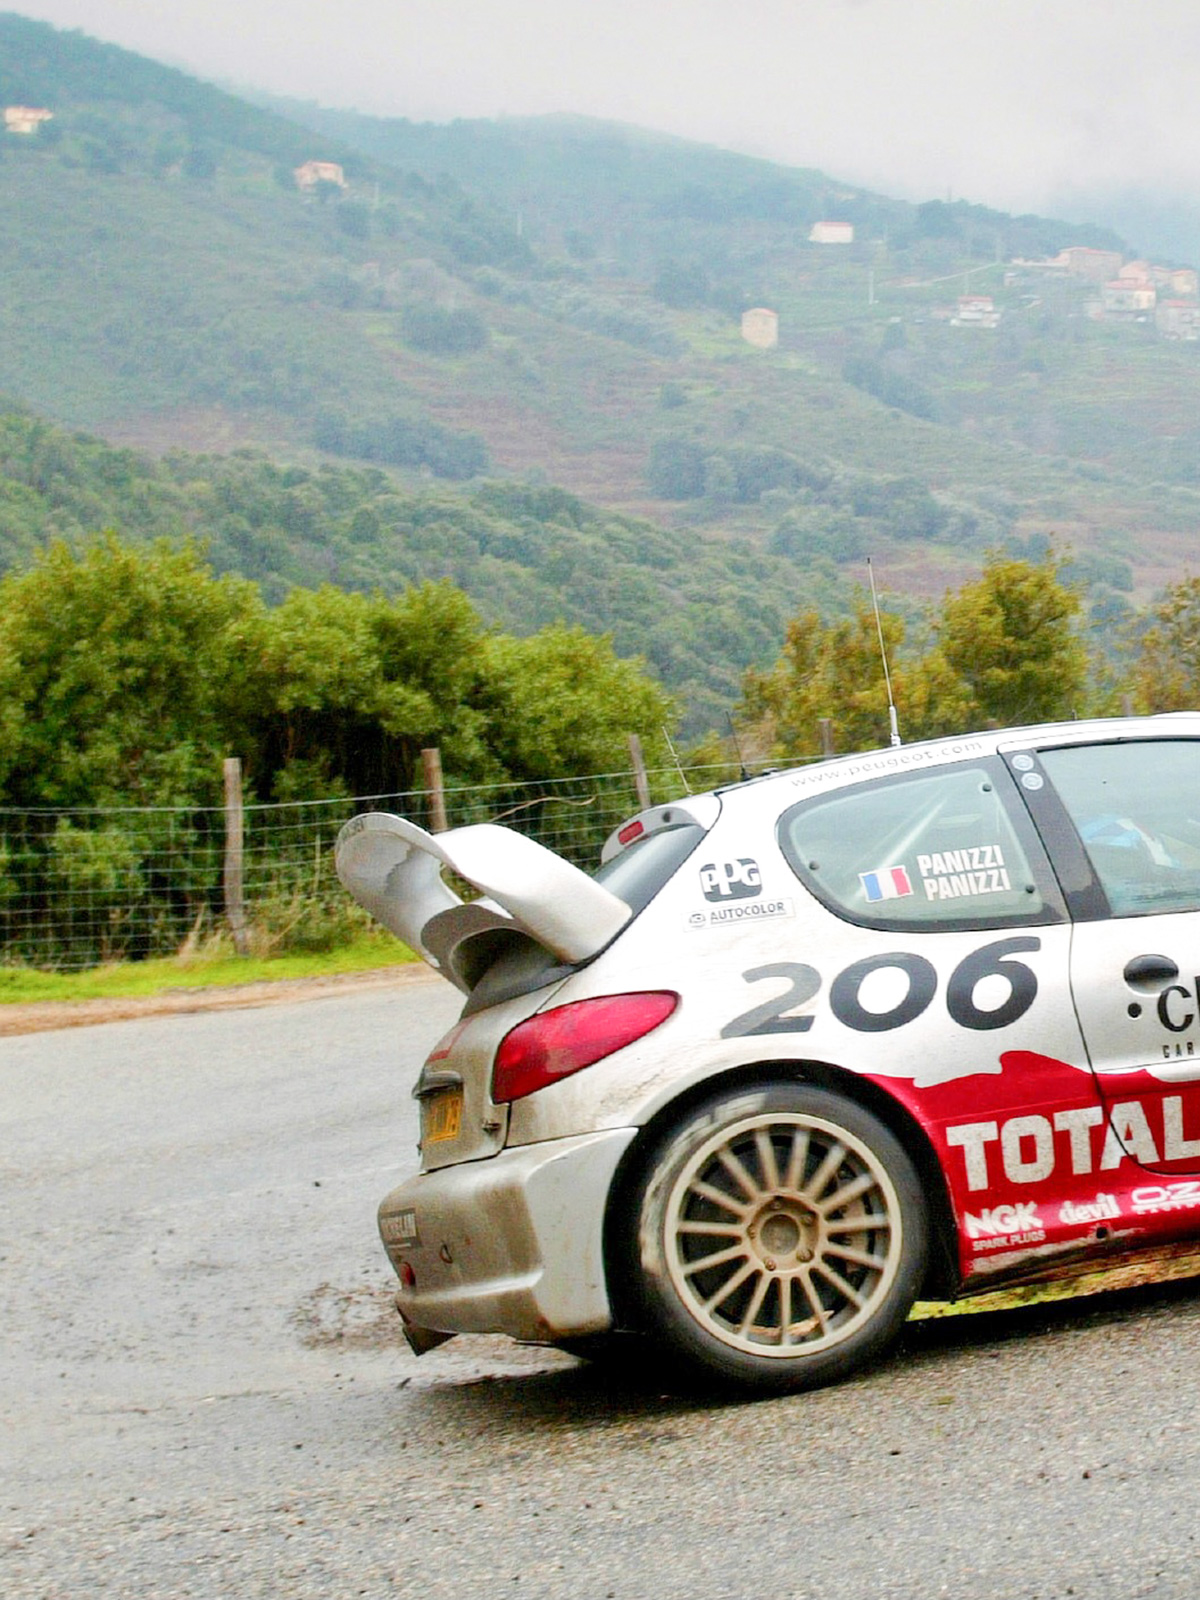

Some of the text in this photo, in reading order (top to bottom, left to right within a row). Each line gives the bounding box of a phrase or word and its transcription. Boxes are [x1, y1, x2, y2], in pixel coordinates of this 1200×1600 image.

[791, 740, 983, 788] www.peugeot.com
[917, 845, 1003, 877] PANIZZI
[700, 858, 761, 897] PPG
[925, 868, 1011, 900] PANIZZI
[710, 902, 785, 921] AUTOCOLOR
[720, 936, 1042, 1039] 206
[1162, 1042, 1194, 1058] CAR
[964, 1201, 1044, 1239] NGK
[1059, 1193, 1122, 1225] devil
[973, 1229, 1047, 1252] SPARK PLUGS
